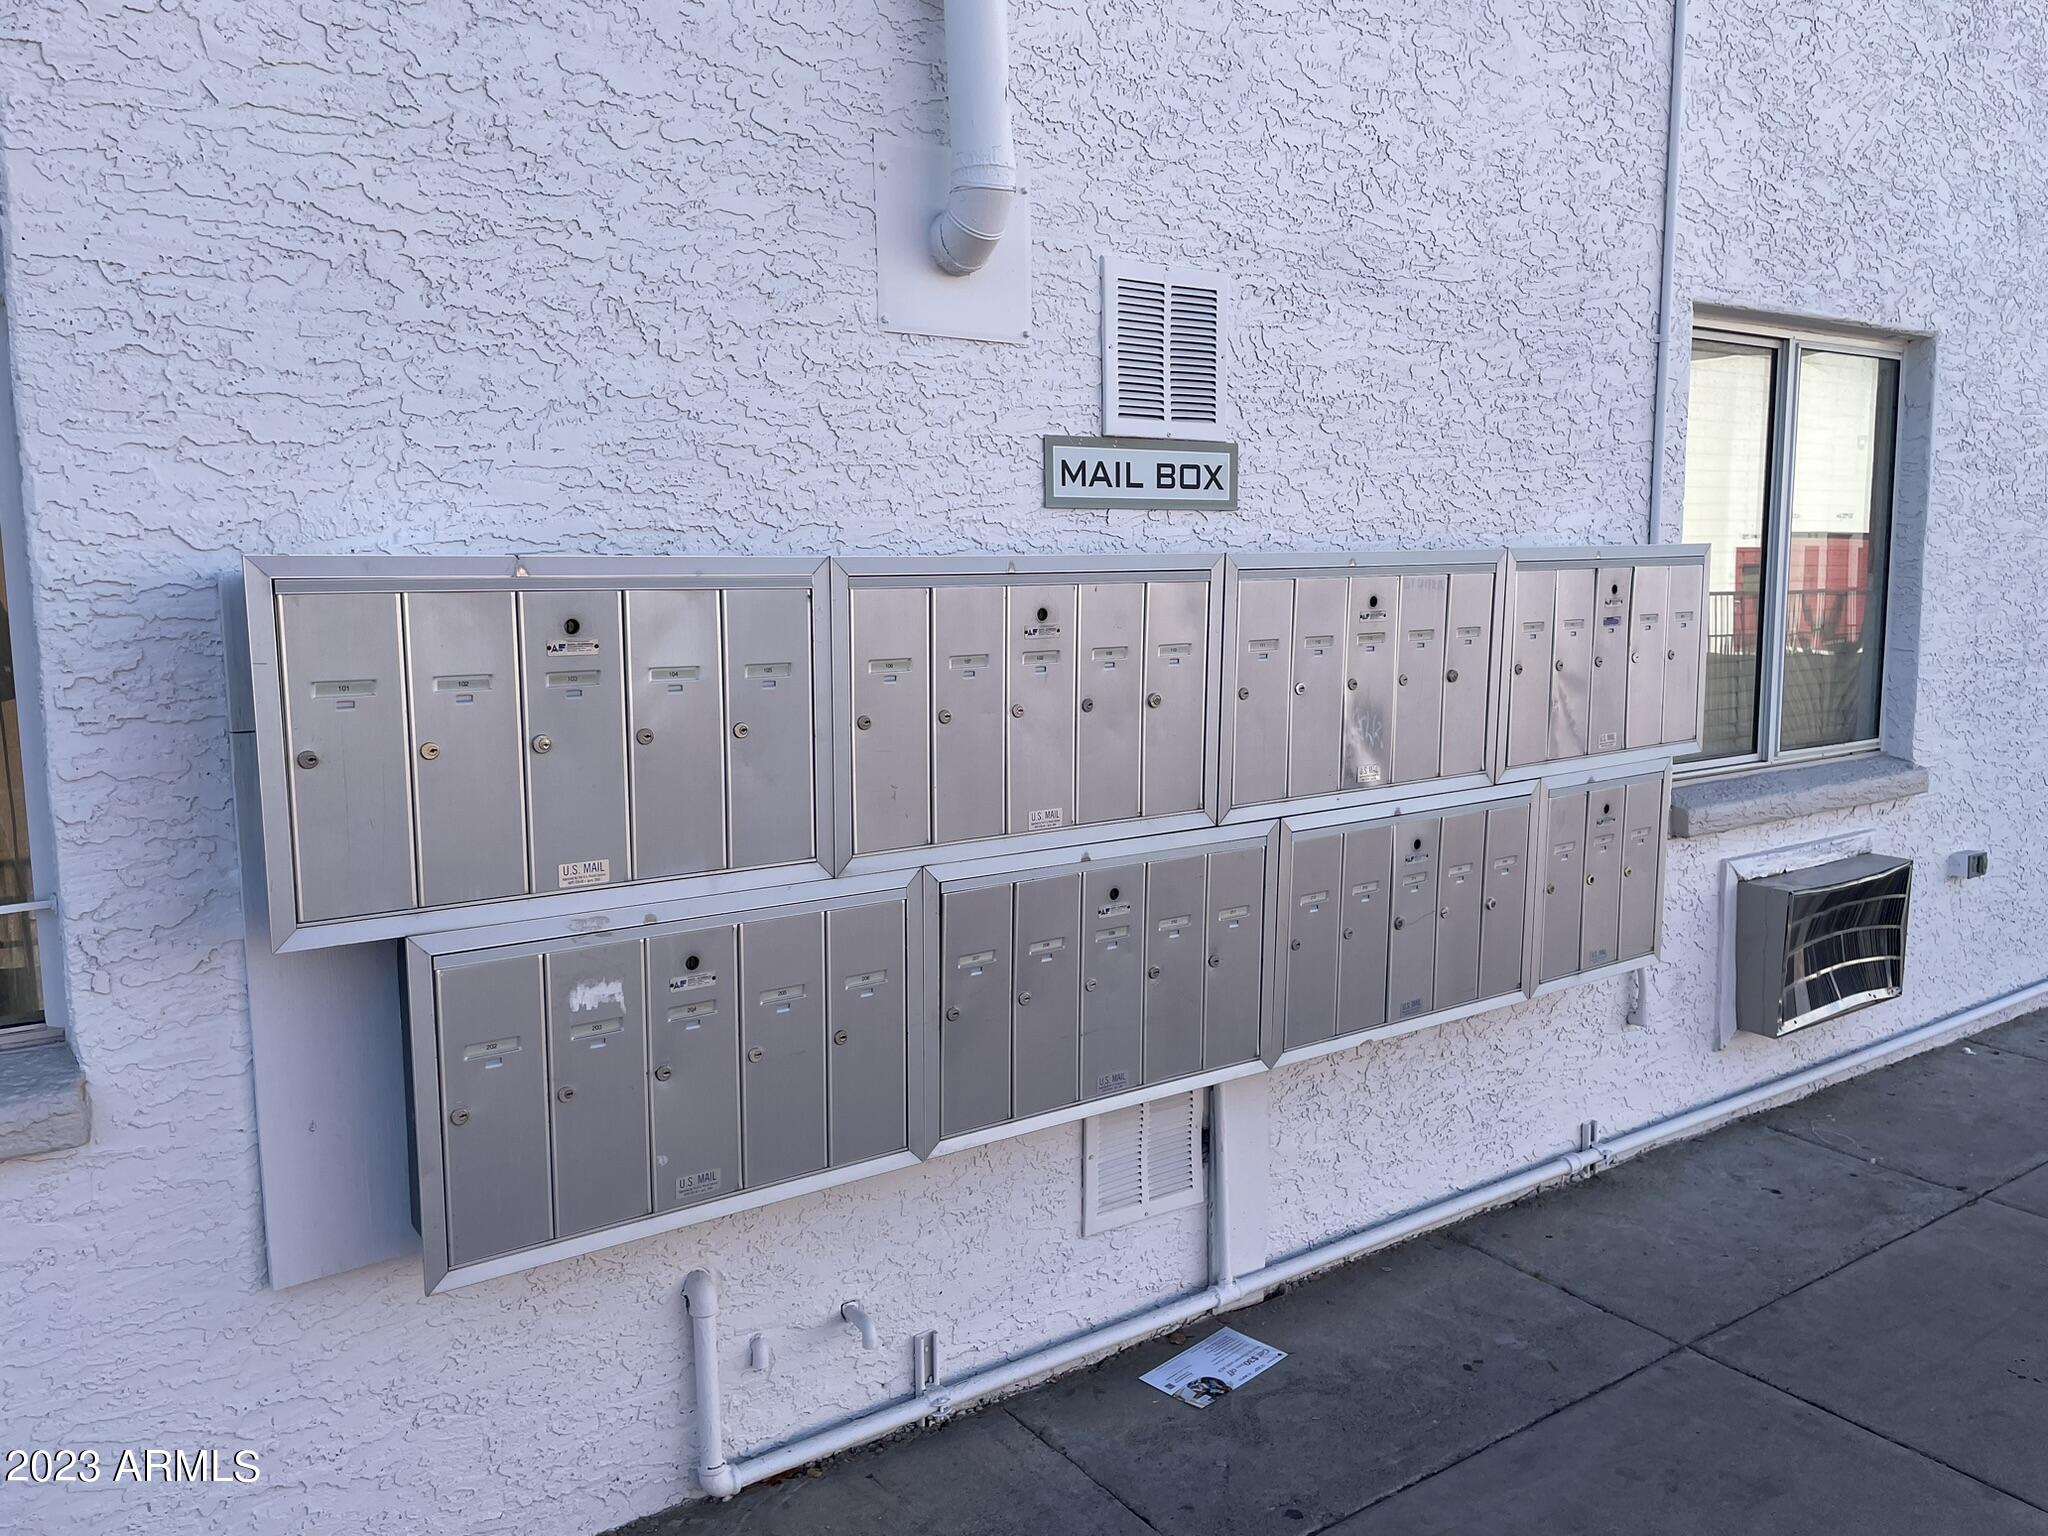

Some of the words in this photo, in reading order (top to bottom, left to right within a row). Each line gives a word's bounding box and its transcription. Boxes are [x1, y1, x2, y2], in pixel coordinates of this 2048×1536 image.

[1061, 460, 1144, 488] MAIL
[1156, 462, 1224, 490] BOX
[1044, 809, 1060, 820] MAIL
[562, 864, 581, 877] U.S.
[583, 861, 605, 873] MAIL
[697, 1171, 717, 1184] MAIL
